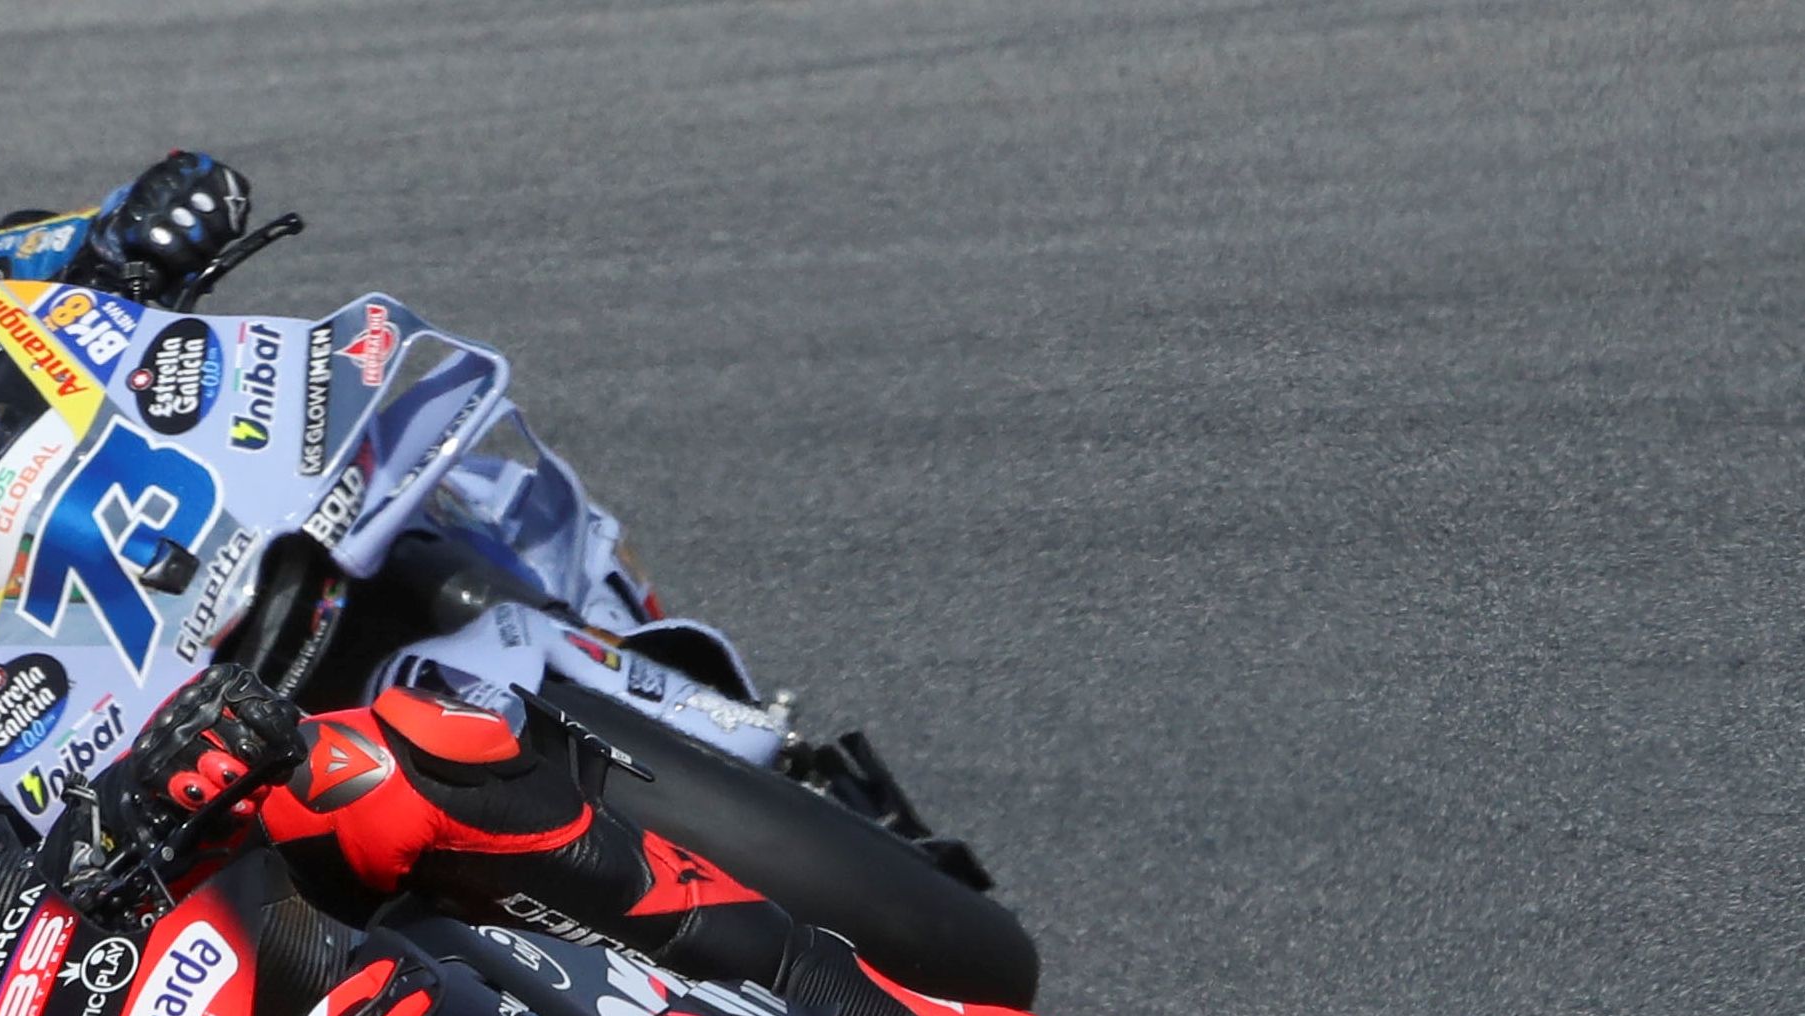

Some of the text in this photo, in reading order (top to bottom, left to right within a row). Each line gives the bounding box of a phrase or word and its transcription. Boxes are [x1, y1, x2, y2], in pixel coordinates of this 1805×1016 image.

[46, 288, 130, 365] BK8
[102, 301, 137, 332] NEWS
[148, 336, 183, 418] Estrella
[172, 337, 206, 415] Galicia
[229, 321, 283, 452] Unibat
[307, 380, 328, 444] GLOW
[302, 445, 323, 476] MS
[303, 464, 366, 542] BOLD
[17, 415, 224, 687] 73
[176, 528, 254, 663] Gigetta
[13, 703, 129, 816] Unibat
[96, 942, 127, 989] PLAY
